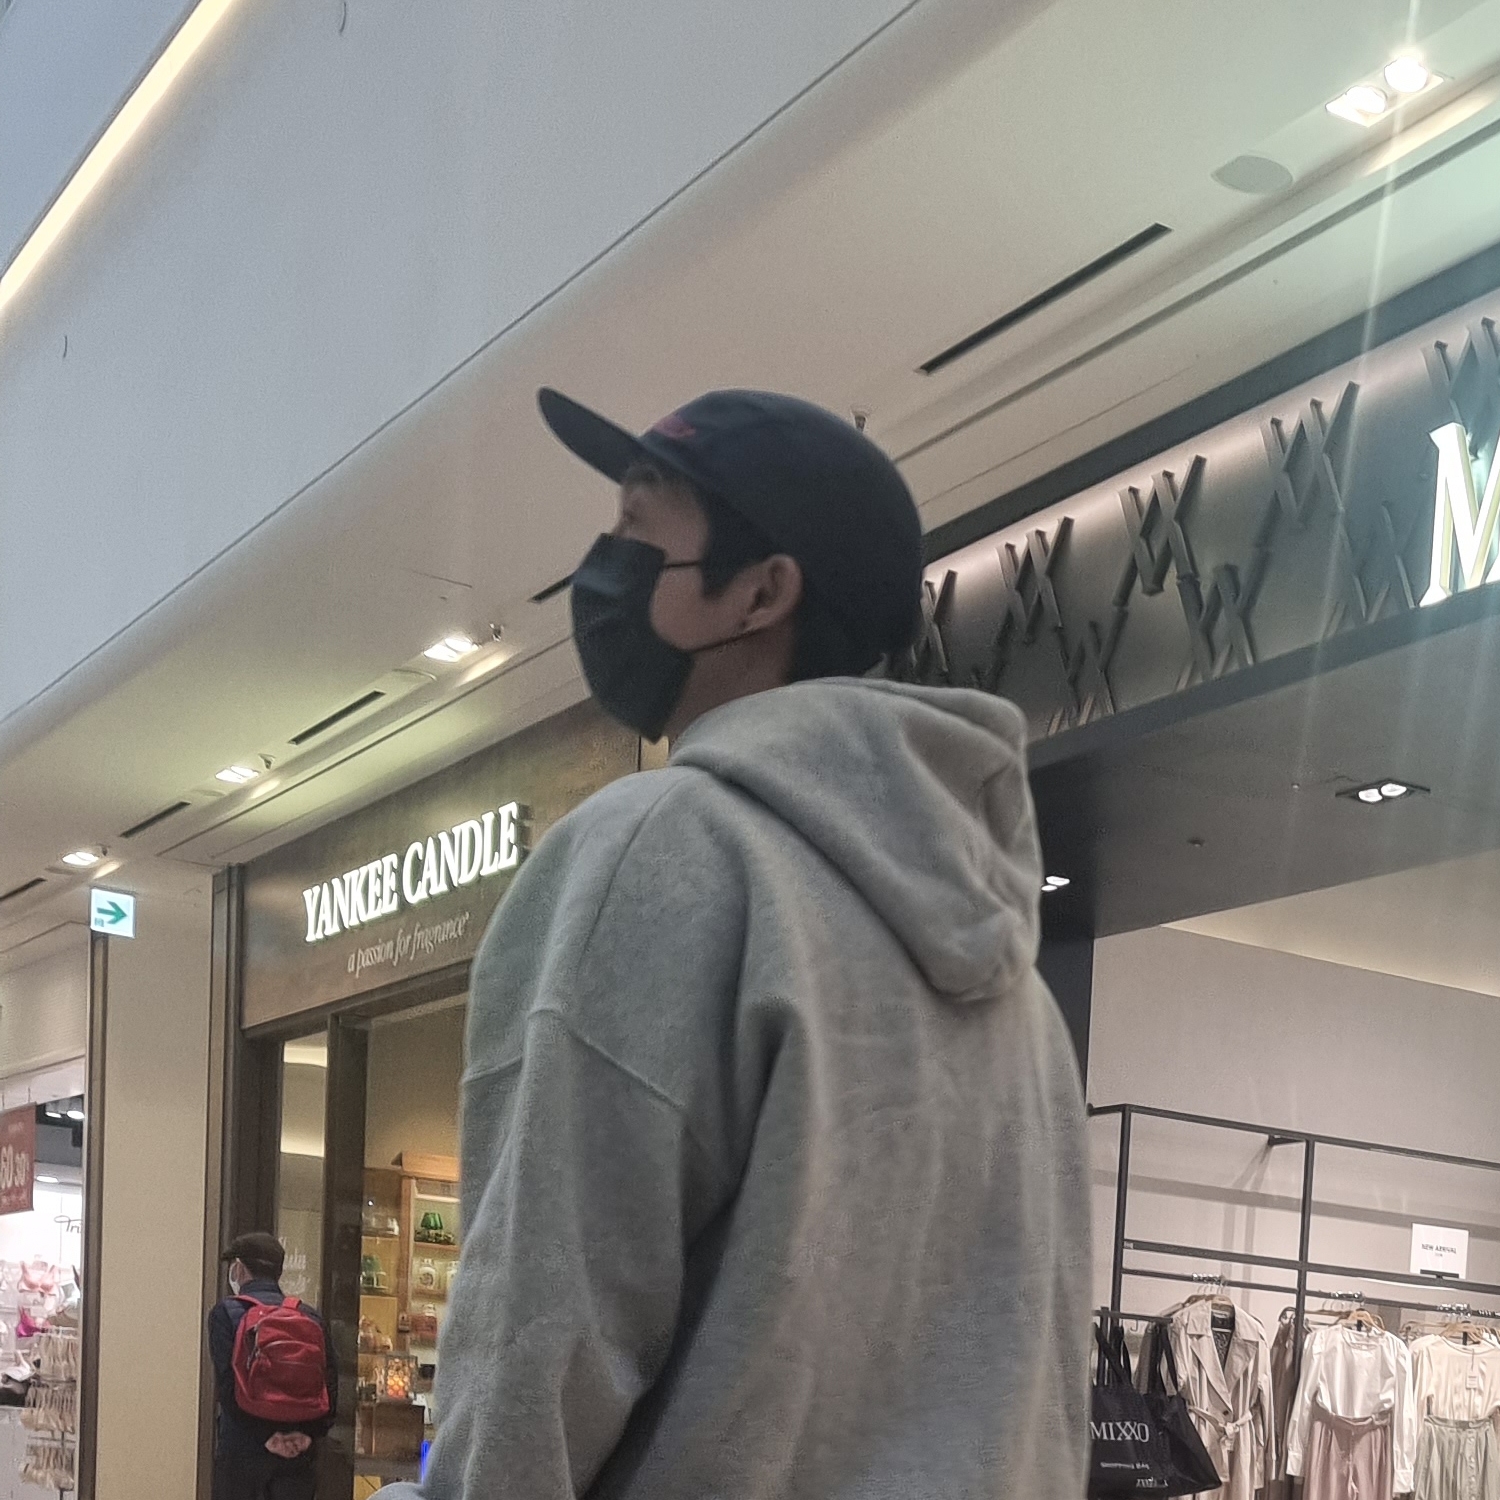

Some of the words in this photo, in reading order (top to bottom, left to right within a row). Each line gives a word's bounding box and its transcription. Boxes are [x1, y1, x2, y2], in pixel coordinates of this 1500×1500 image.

[302, 853, 399, 943] YANKEE
[402, 801, 519, 905] CANDLE
[347, 952, 356, 974] a
[355, 938, 394, 979] passion
[392, 927, 413, 967] for
[1089, 1420, 1150, 1443] MIXXO
